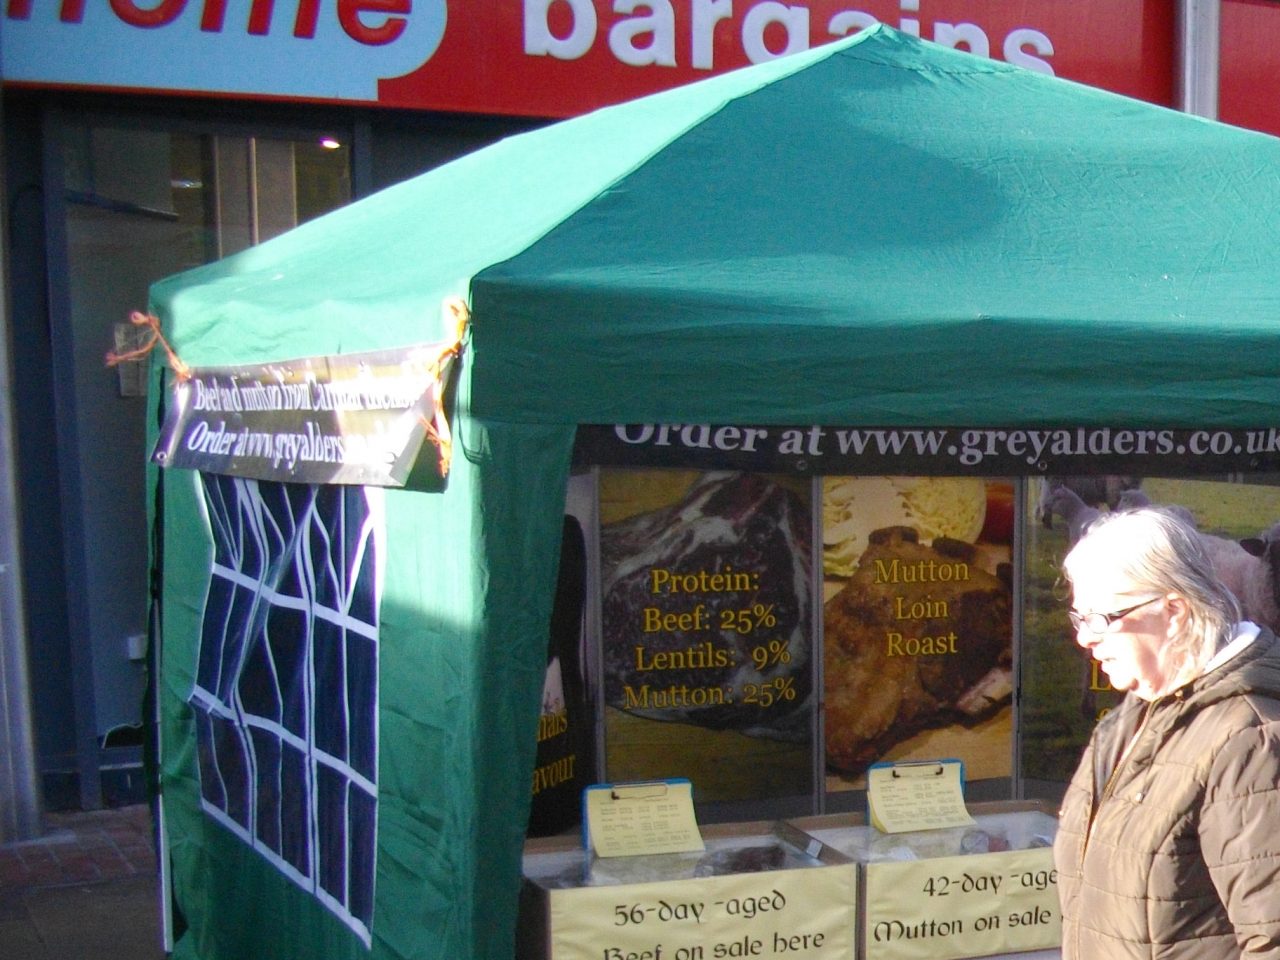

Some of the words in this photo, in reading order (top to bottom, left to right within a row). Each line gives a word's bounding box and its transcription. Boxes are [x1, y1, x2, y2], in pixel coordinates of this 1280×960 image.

[5, 0, 412, 47] me
[522, 0, 1056, 77] bargns
[187, 420, 236, 456] Order
[615, 423, 768, 453] Order
[778, 424, 832, 456] at
[652, 565, 761, 594] Protein:
[874, 559, 970, 584] Mutton
[643, 605, 711, 633] Beef:
[719, 603, 777, 634] 25%
[895, 595, 948, 620] Loin
[635, 642, 737, 672] Lentils:
[751, 640, 791, 671] 9%
[886, 631, 958, 657] Roast
[623, 685, 734, 710] Mutton:
[743, 676, 796, 707] 25%
[1010, 869, 1059, 891] -age
[873, 917, 963, 943] Mutton
[974, 912, 1000, 933] on
[1008, 905, 1052, 928] sale
[713, 935, 761, 958] sale
[773, 930, 825, 954] here
